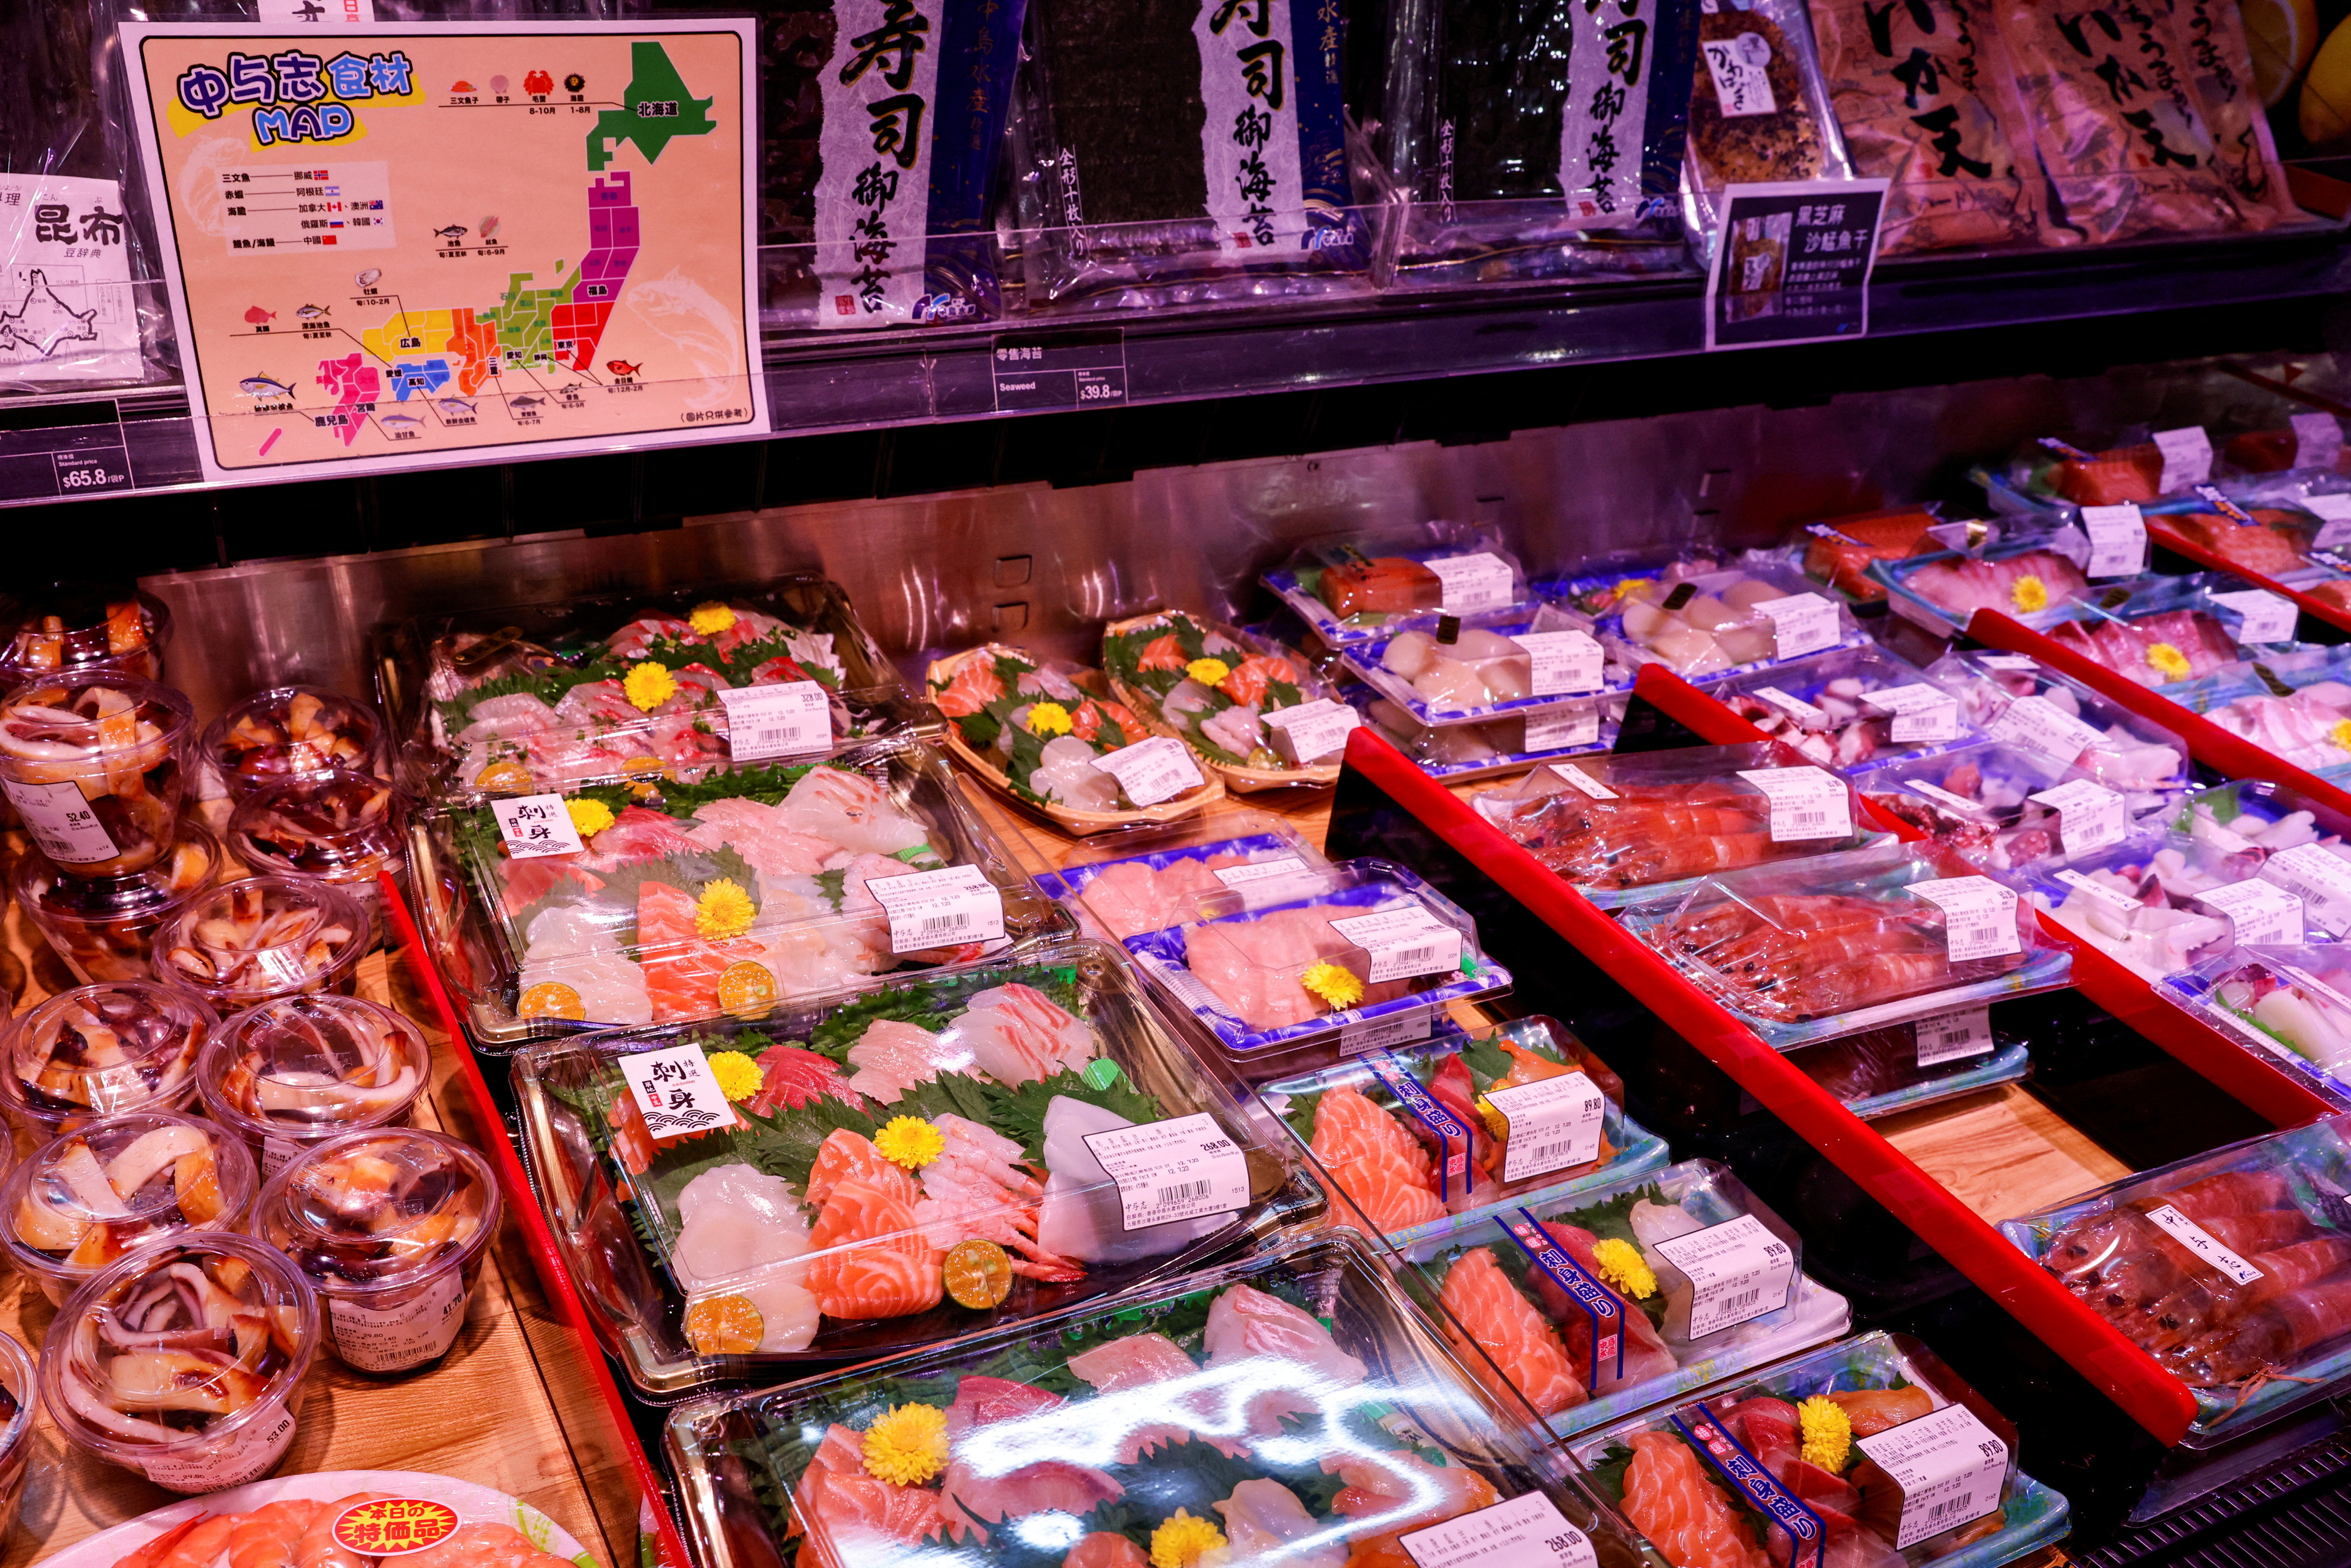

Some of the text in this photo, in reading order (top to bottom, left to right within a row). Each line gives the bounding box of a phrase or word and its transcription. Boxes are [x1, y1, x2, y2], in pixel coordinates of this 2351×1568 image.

[181, 54, 410, 115] 中与志食材
[638, 101, 678, 117] 北海道
[255, 105, 351, 143] MAP
[222, 172, 312, 183] 三文魚 挪威
[297, 188, 323, 197] 阿根廷
[299, 203, 326, 213] 加拿大
[351, 201, 368, 211] 澳洲
[1059, 148, 1083, 255] 全形十枚入り
[35, 204, 123, 245] 昆布
[301, 217, 370, 229] 俄羅斯 韓國
[304, 236, 321, 245] 中國
[64, 247, 102, 259] 豆辞典
[356, 298, 390, 307] 旬:10-2月
[401, 338, 420, 348] 広島
[996, 347, 1042, 361] 零售海苔
[1000, 382, 1035, 392] Seaweed
[801, 693, 823, 702] 328.00
[66, 811, 91, 822] 52.40
[517, 804, 552, 839] 刺身
[683, 1059, 700, 1077] 特選
[651, 1061, 695, 1110] 刺身
[1396, 1081, 1461, 1137] 刺身盛り
[1585, 1097, 1601, 1112] 89.80
[1200, 1139, 1231, 1151] 268.00
[1163, 1198, 1185, 1207] 099659
[1188, 1194, 1209, 1203] 268006
[1147, 1203, 1196, 1216] 香港中島水產有限公司
[1763, 1243, 1786, 1257] 89.80
[1539, 1249, 1615, 1318] 刺身盛り
[443, 1293, 462, 1316] 41.70
[266, 1419, 290, 1444] 53.00
[1978, 1440, 2003, 1458] 89.80
[1726, 1455, 1816, 1540] 刺身盛り
[370, 1507, 425, 1520] 本日の
[354, 1519, 440, 1543] 特価品
[1545, 1531, 1582, 1552] 268.00
